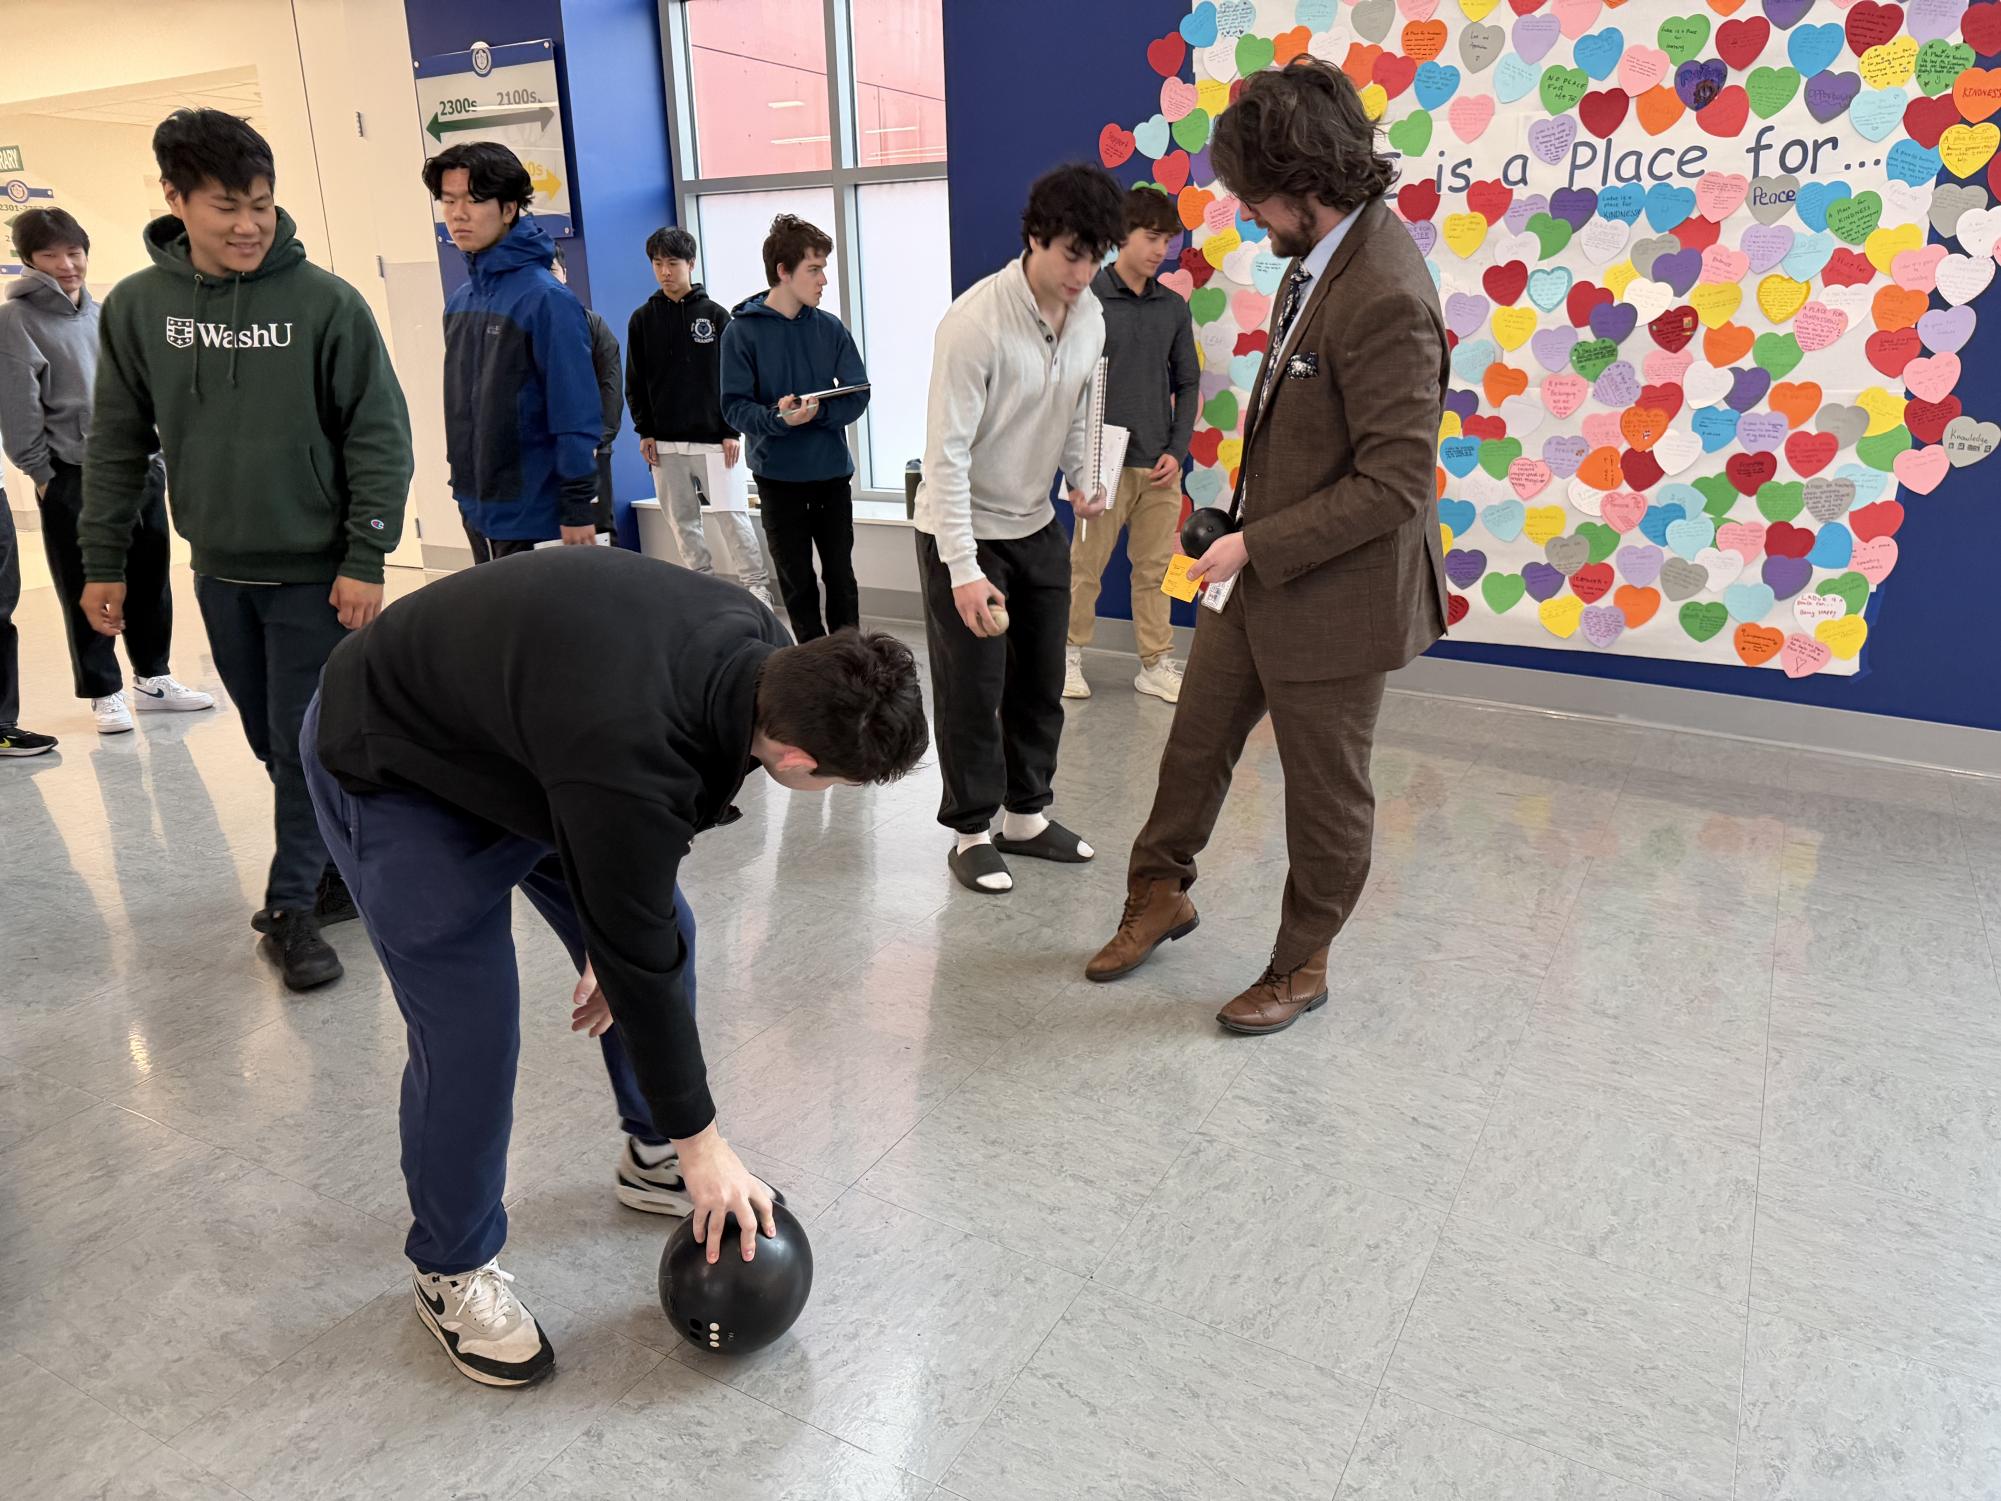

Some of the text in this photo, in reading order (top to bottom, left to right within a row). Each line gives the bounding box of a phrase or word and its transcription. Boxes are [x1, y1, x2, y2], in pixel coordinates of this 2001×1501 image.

[496, 88, 537, 106] 2100s
[439, 98, 478, 116] 2300s
[1436, 150, 1472, 193] is
[1502, 154, 1529, 187] a
[1568, 138, 1708, 190] Place
[1753, 186, 1797, 207] Peace
[196, 322, 293, 349] WashU
[1951, 428, 1988, 445] Knowledge
